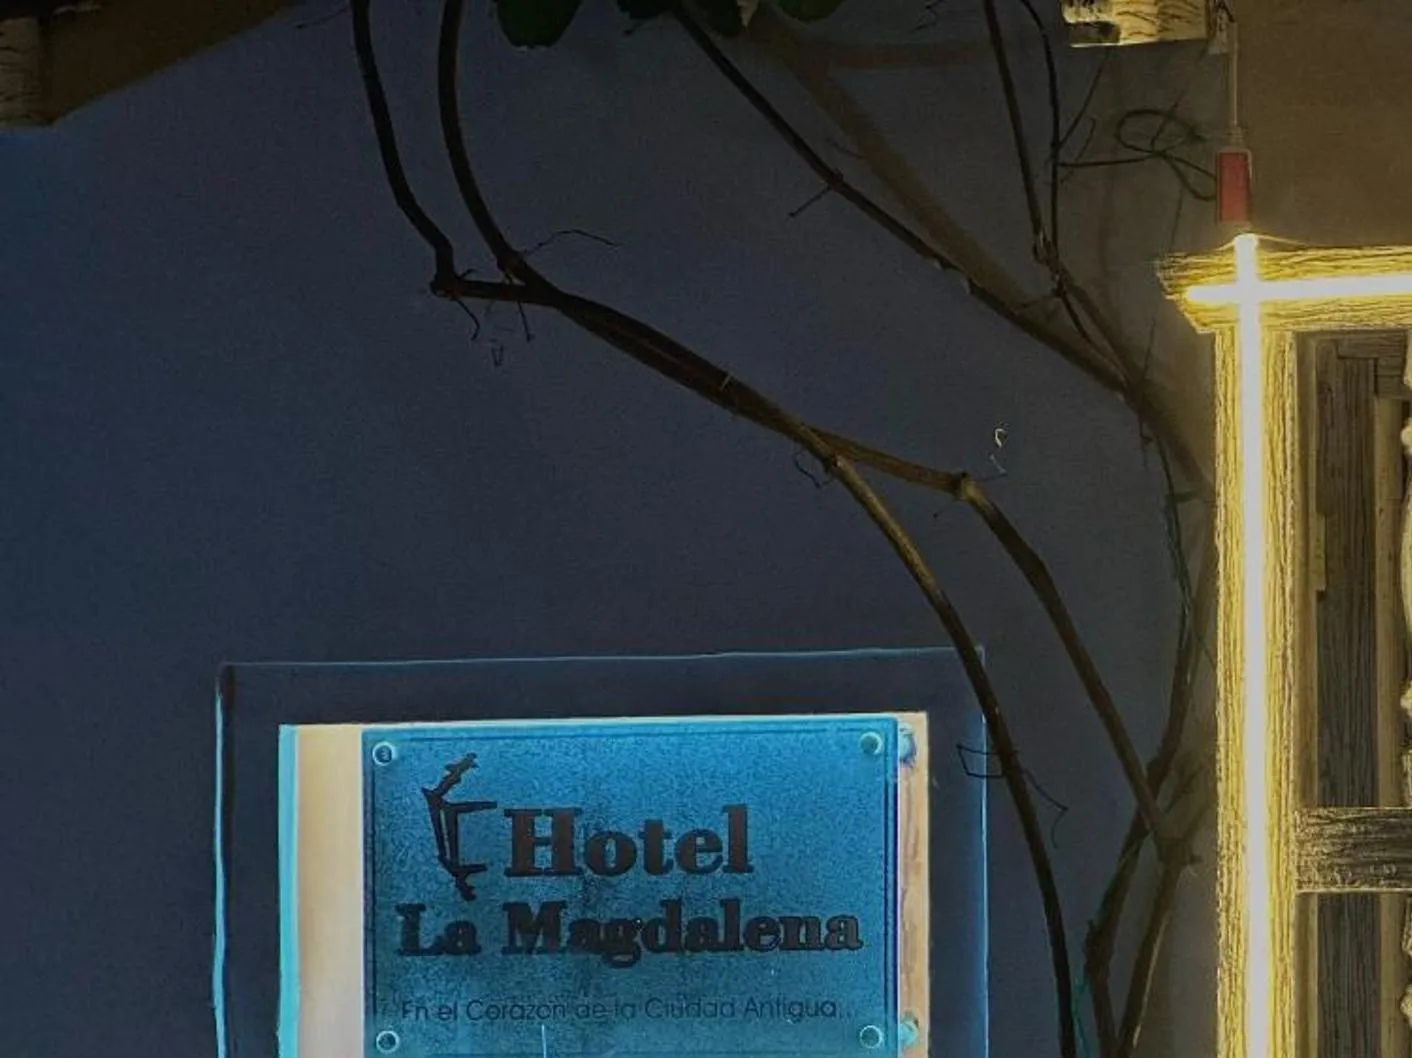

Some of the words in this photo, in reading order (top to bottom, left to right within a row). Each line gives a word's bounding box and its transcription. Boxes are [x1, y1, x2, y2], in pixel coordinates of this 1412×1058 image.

[503, 803, 754, 877] Hotel
[395, 903, 482, 956] La
[502, 898, 864, 968] Magdalena
[402, 1000, 428, 1020] En
[437, 1000, 458, 1021] el
[575, 998, 607, 1020] de
[615, 999, 636, 1019] la
[645, 997, 735, 1019] Ciudad
